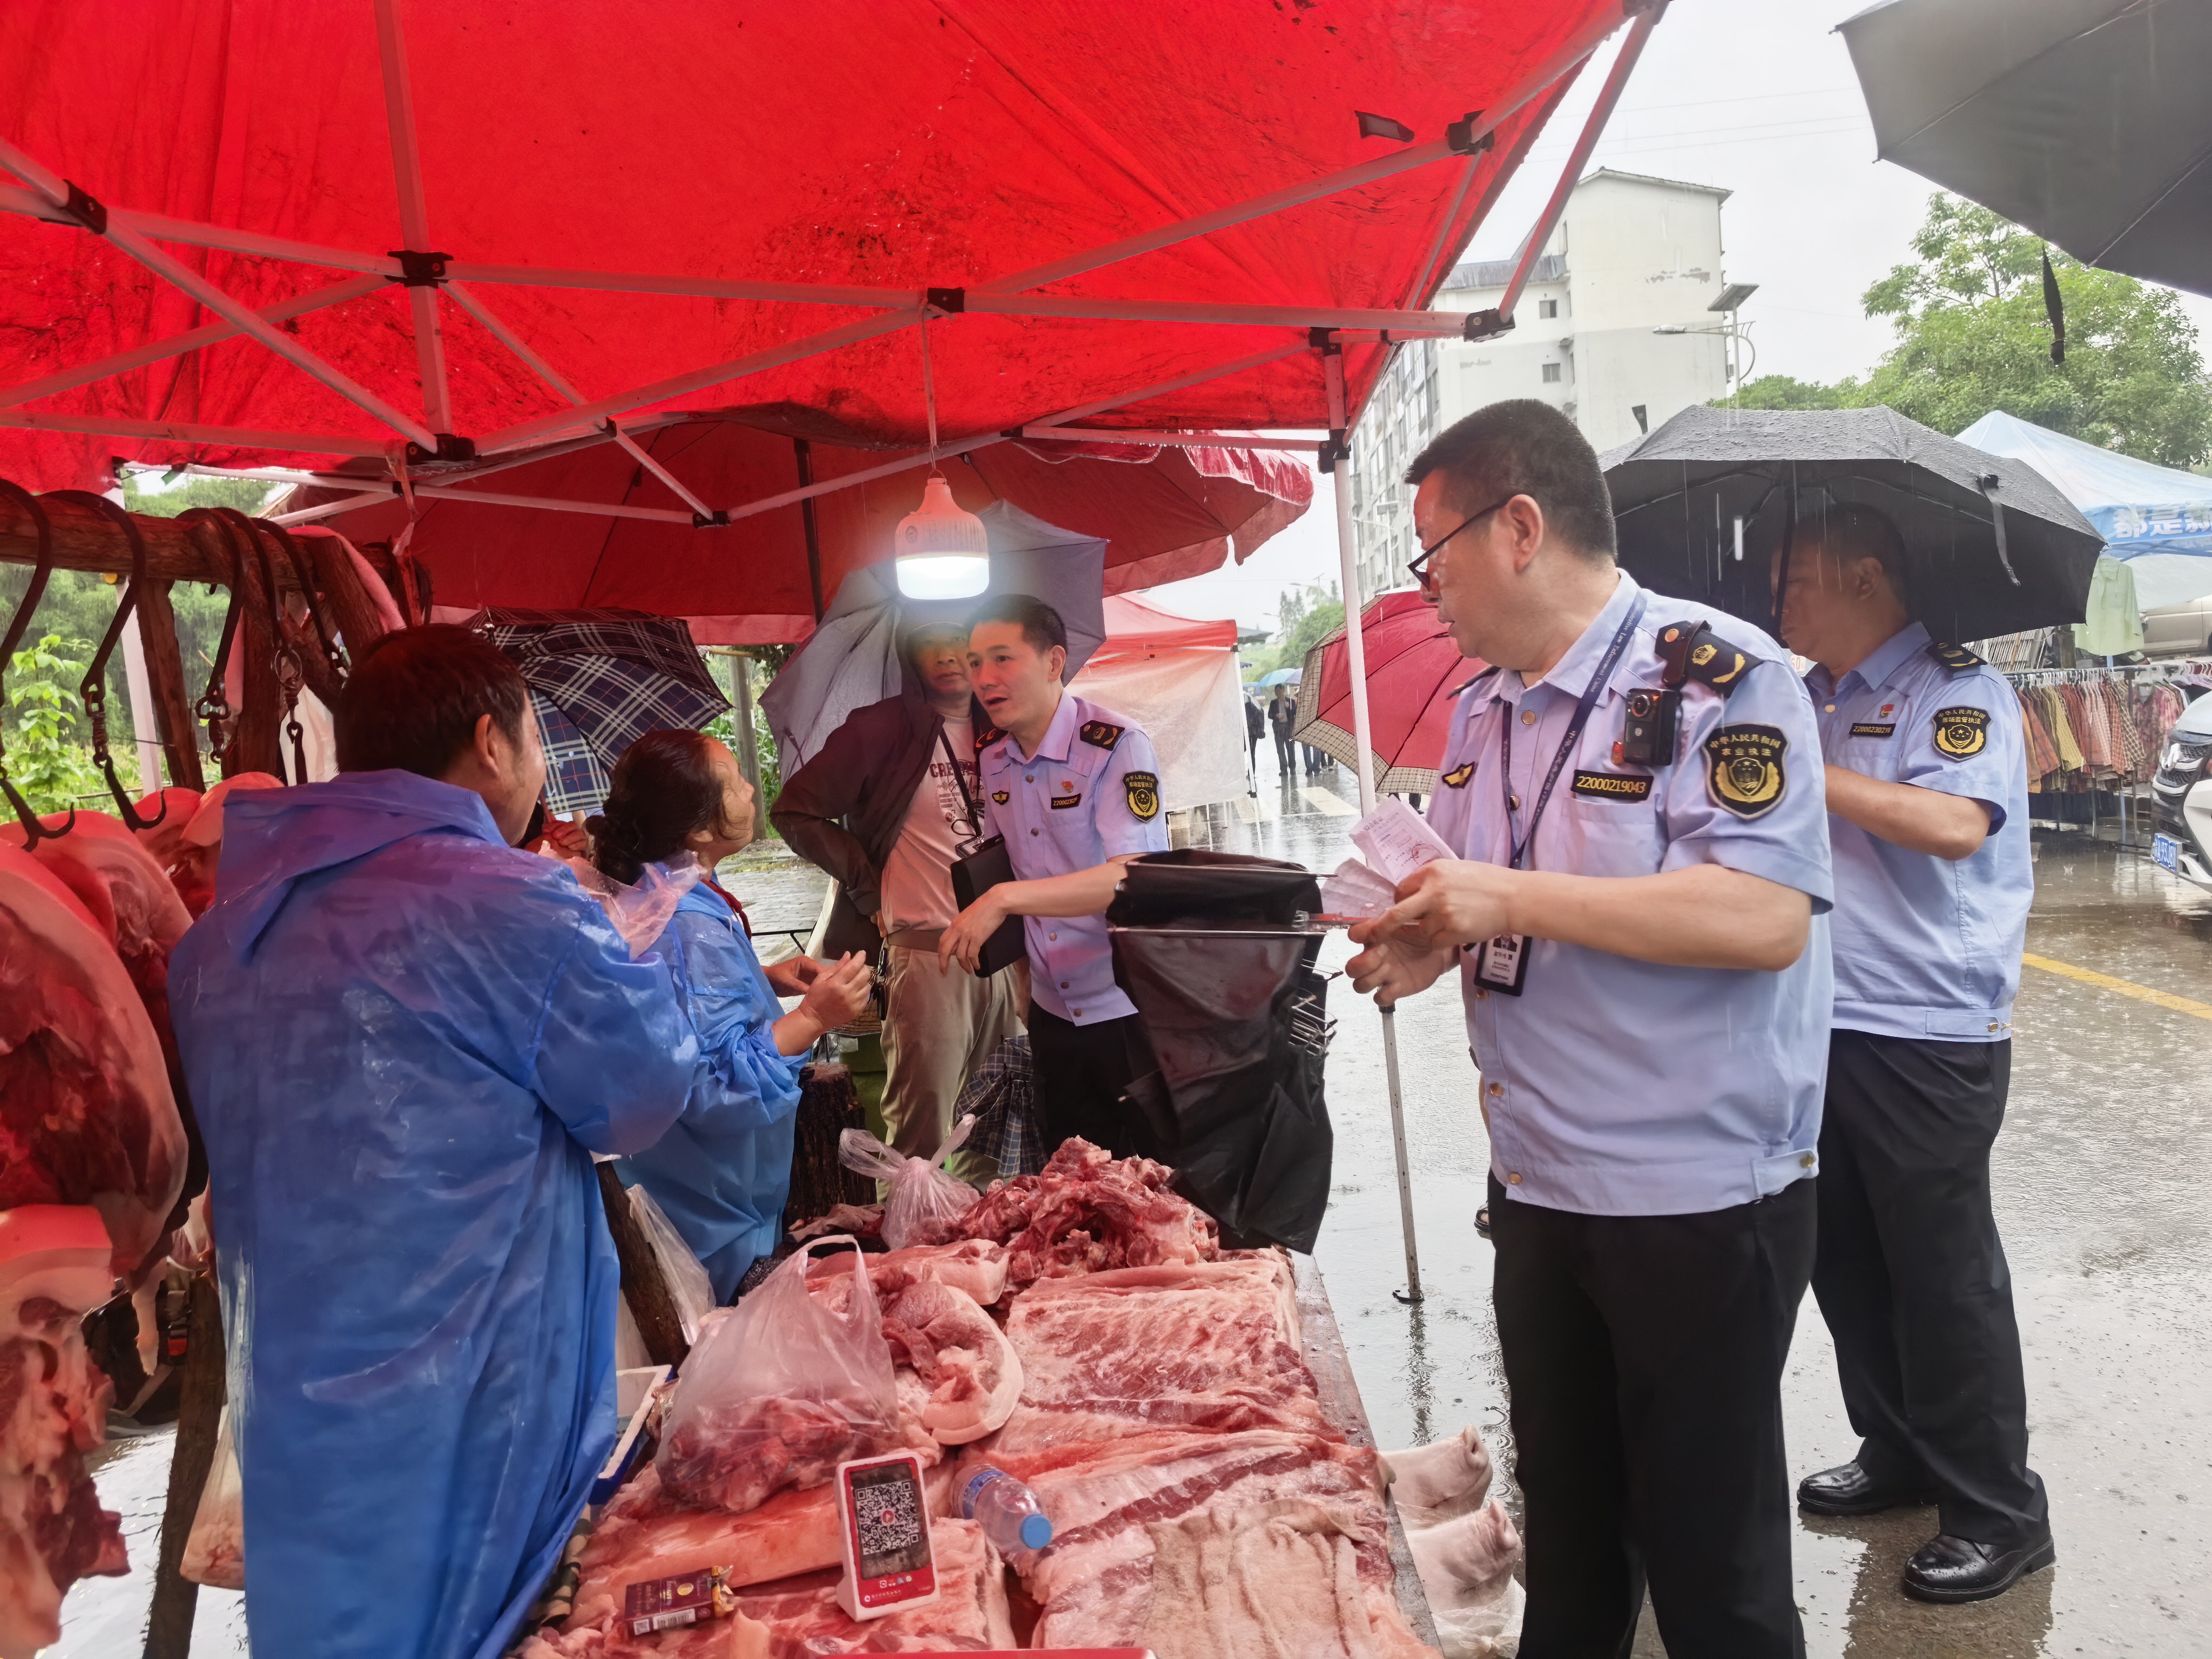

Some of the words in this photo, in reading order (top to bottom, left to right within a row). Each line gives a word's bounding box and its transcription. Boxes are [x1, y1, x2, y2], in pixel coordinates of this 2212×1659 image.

[1710, 733, 1781, 748] 中华人民共和国
[1576, 776, 1646, 793] 22000219043
